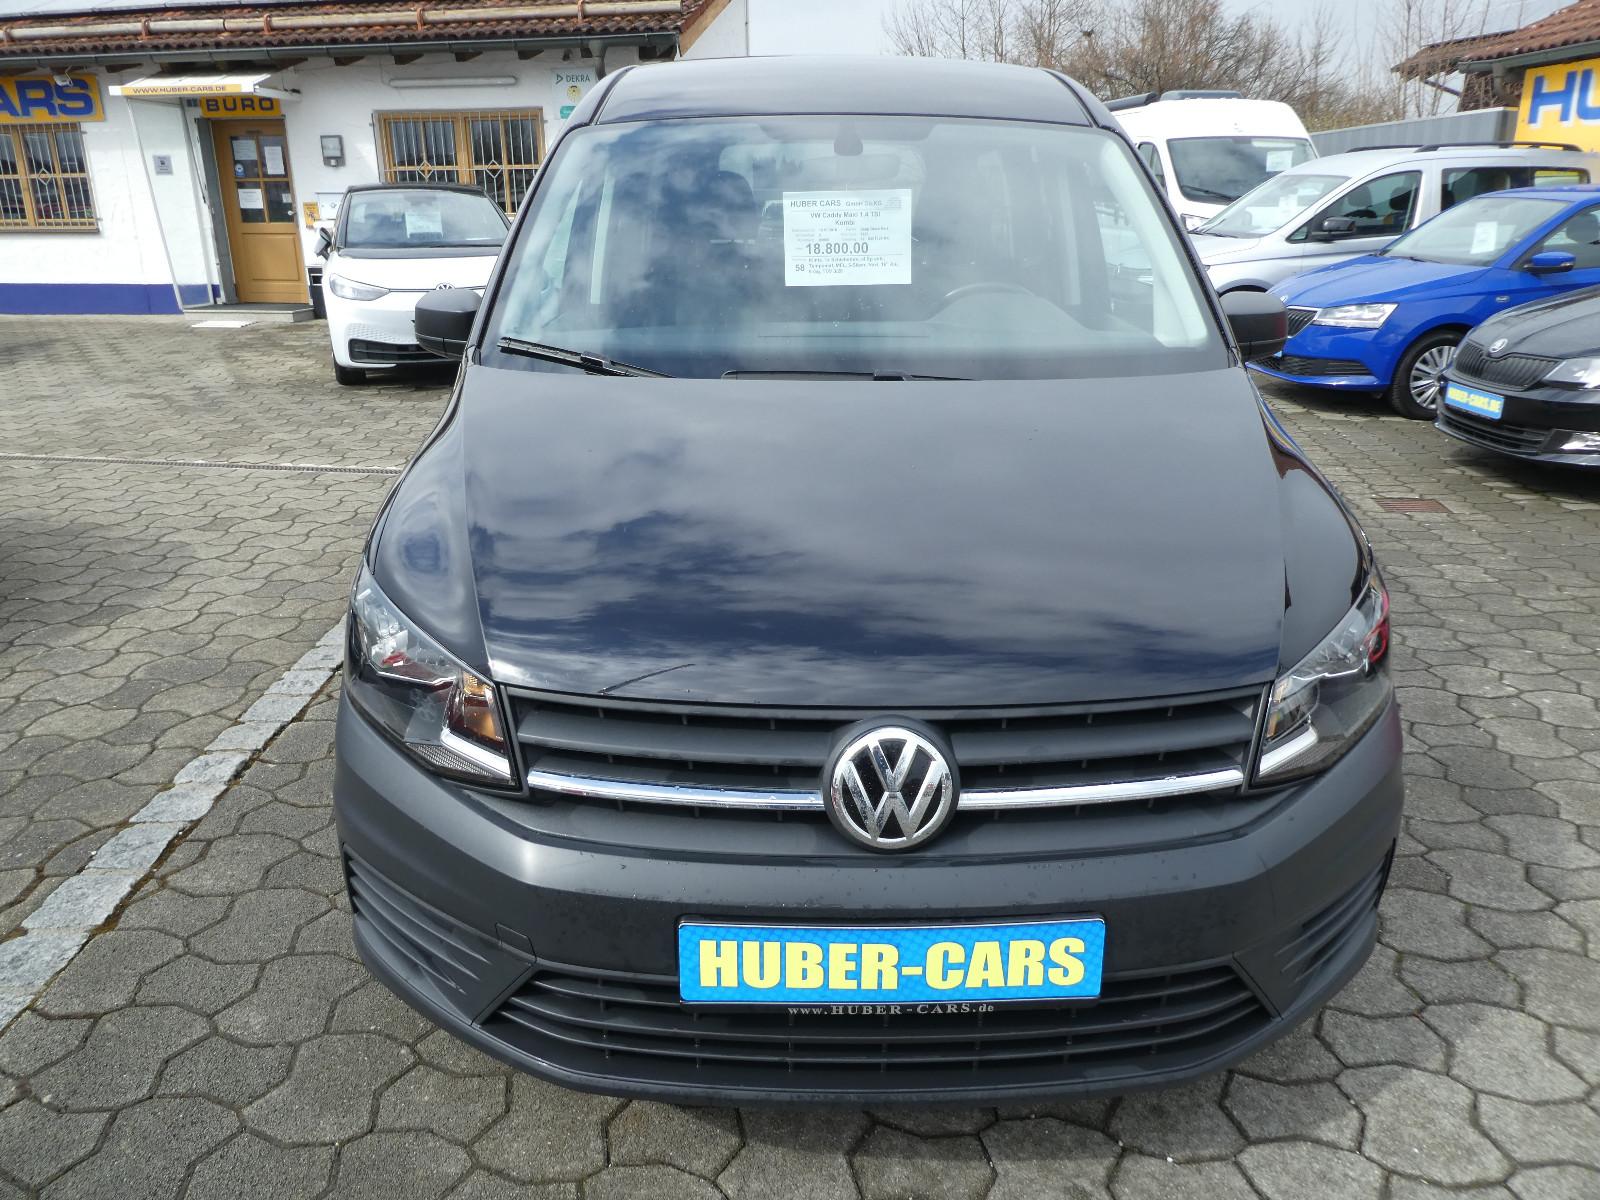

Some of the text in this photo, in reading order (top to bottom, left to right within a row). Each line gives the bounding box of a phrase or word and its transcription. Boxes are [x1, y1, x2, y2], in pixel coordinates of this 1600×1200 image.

[565, 74, 591, 83] DEKRA
[790, 200, 818, 208] HUBER
[819, 199, 841, 207] CARS
[822, 211, 842, 219] Caddy
[805, 242, 869, 255] 18.800.00
[795, 263, 805, 272] 58
[698, 936, 1086, 990] HUBER-CARS
[787, 1002, 995, 1015] www.HUBER-CARS.de
